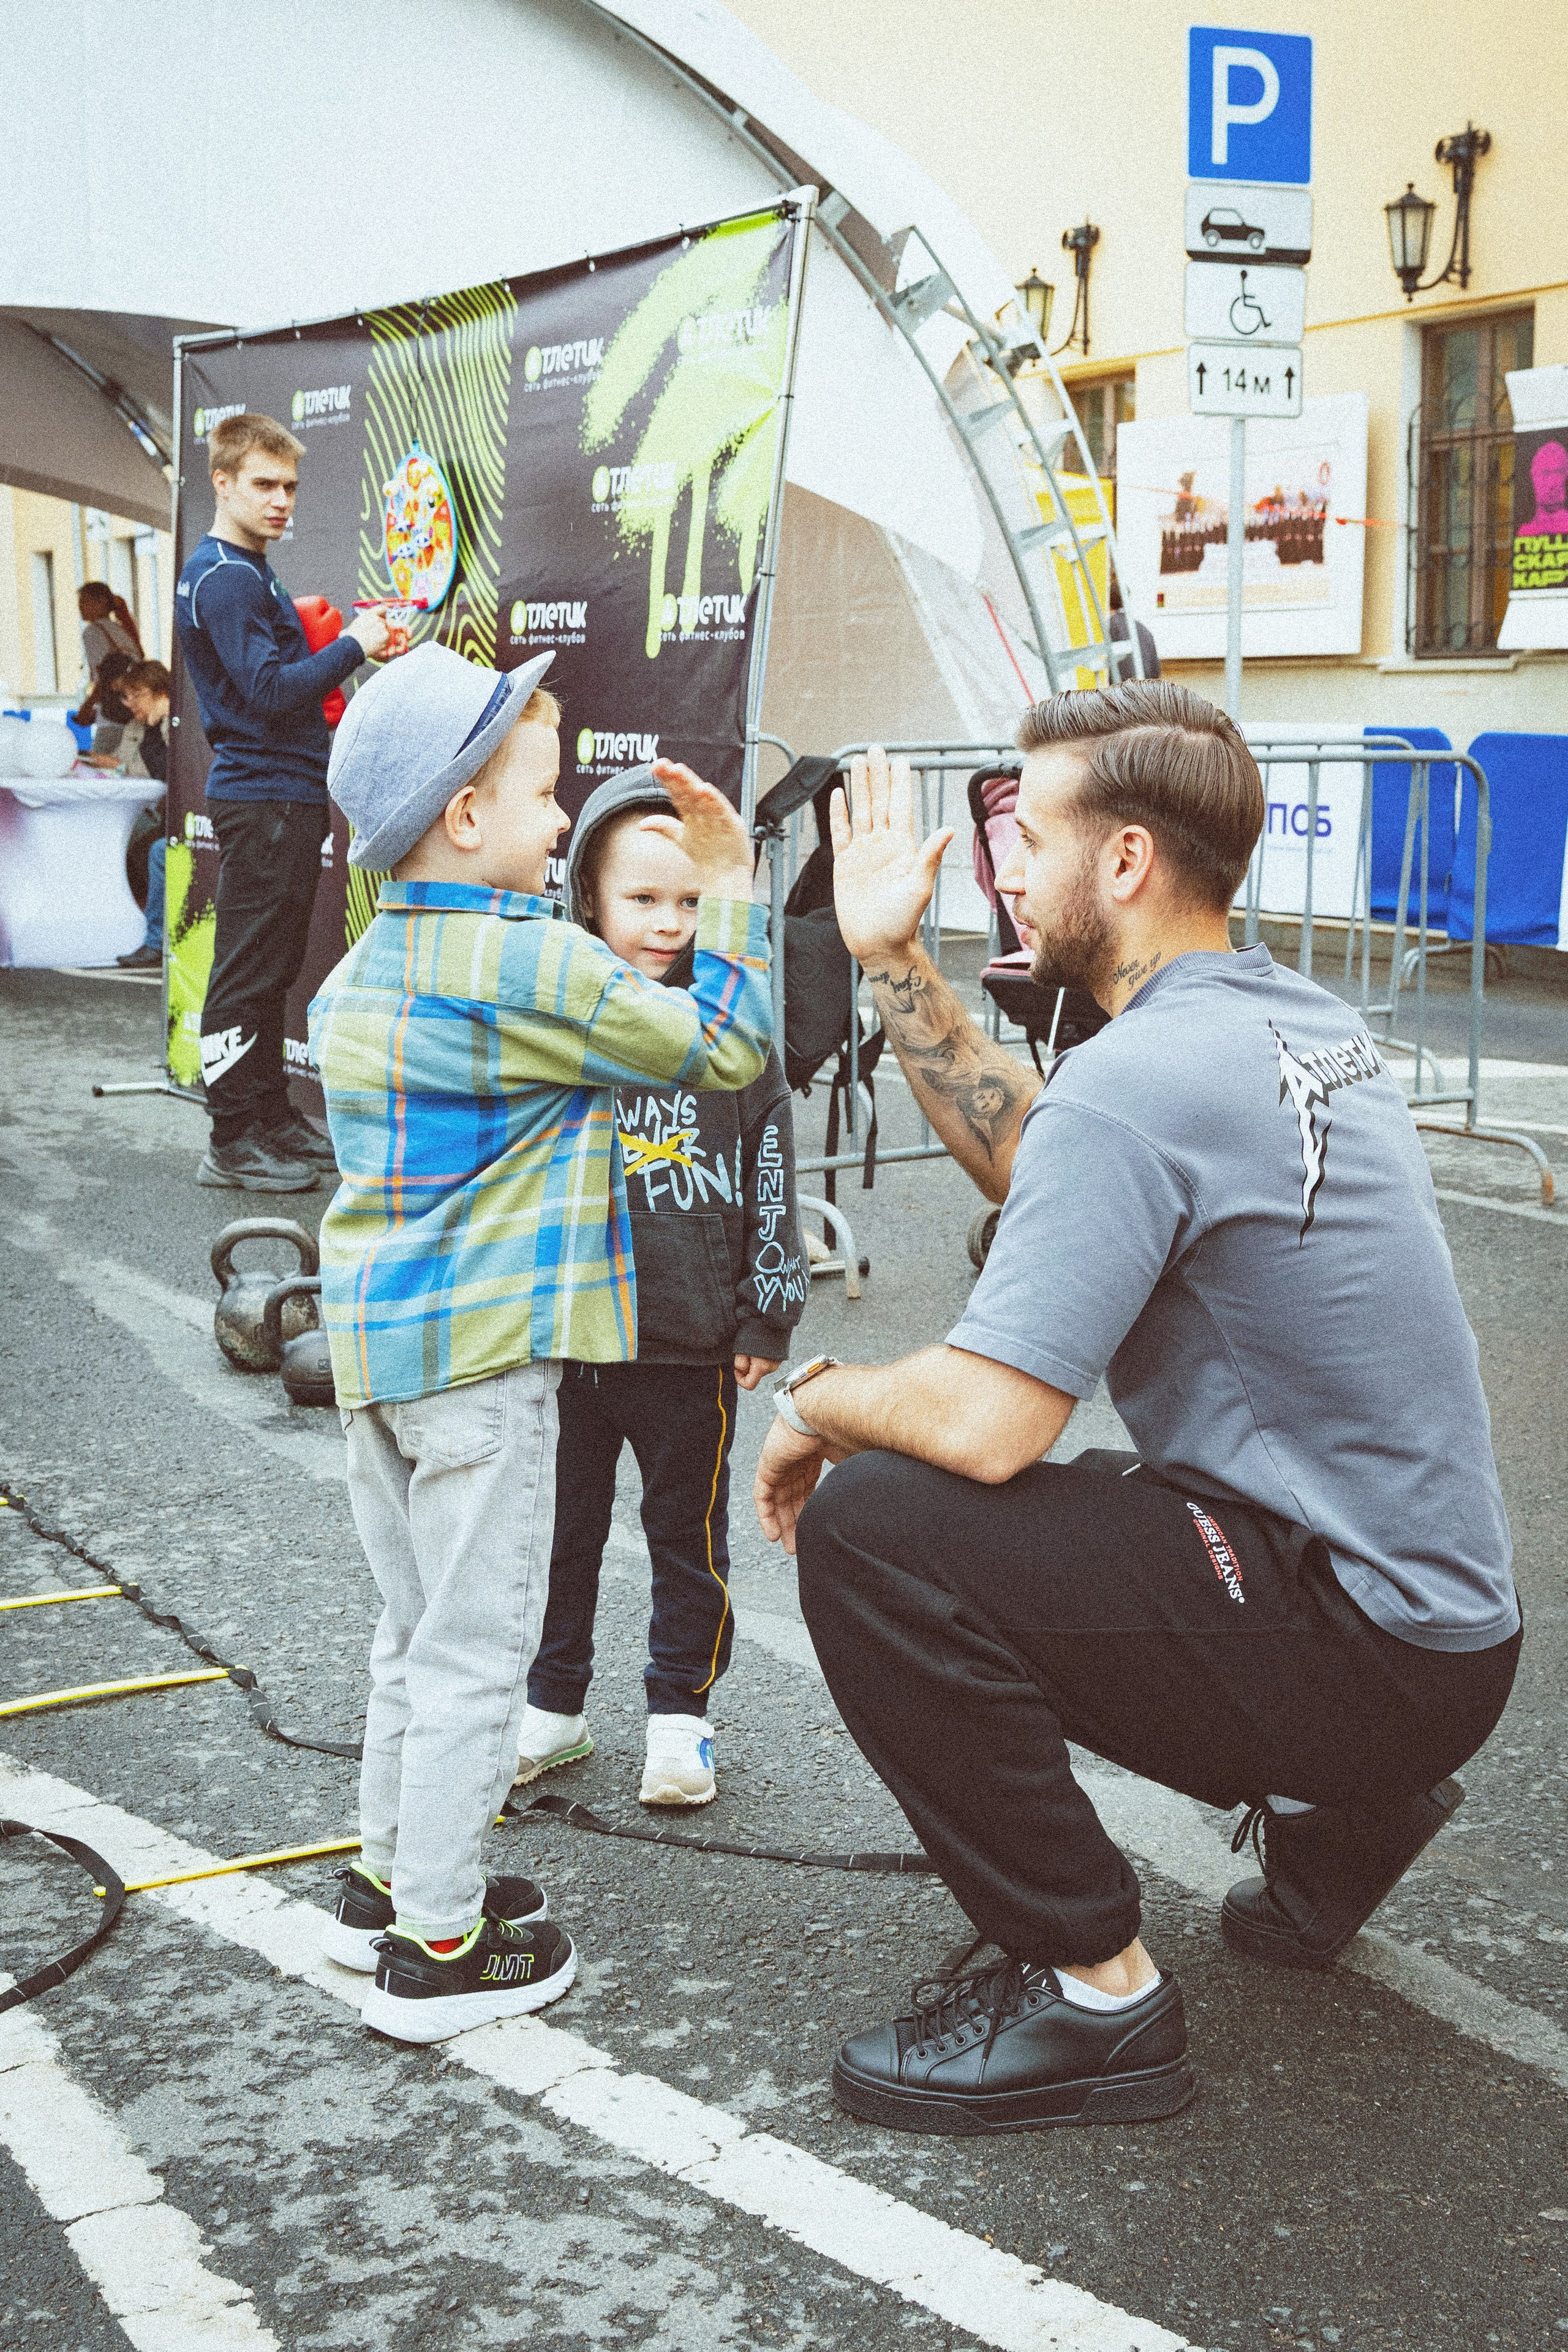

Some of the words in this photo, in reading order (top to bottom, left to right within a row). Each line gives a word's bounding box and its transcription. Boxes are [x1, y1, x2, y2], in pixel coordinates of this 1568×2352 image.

[1212, 45, 1280, 165] P
[1222, 368, 1247, 394] 14
[510, 633, 526, 644] сеть
[529, 631, 586, 646] фитнес-клубов
[679, 628, 745, 643] фитнес-клубов
[576, 764, 594, 774] сеть
[617, 1090, 697, 1132] WAYS
[636, 1134, 744, 1212] FUN!
[754, 1125, 786, 1314] ENJOY
[1186, 1502, 1221, 1544] GUESS
[1213, 1545, 1243, 1599] JEANS
[1193, 1518, 1211, 1548] ORIGINAL
[1208, 1550, 1224, 1580] DESIGNS
[1207, 1515, 1228, 1544] AMERICAN
[1226, 1545, 1243, 1581] TRADITION
